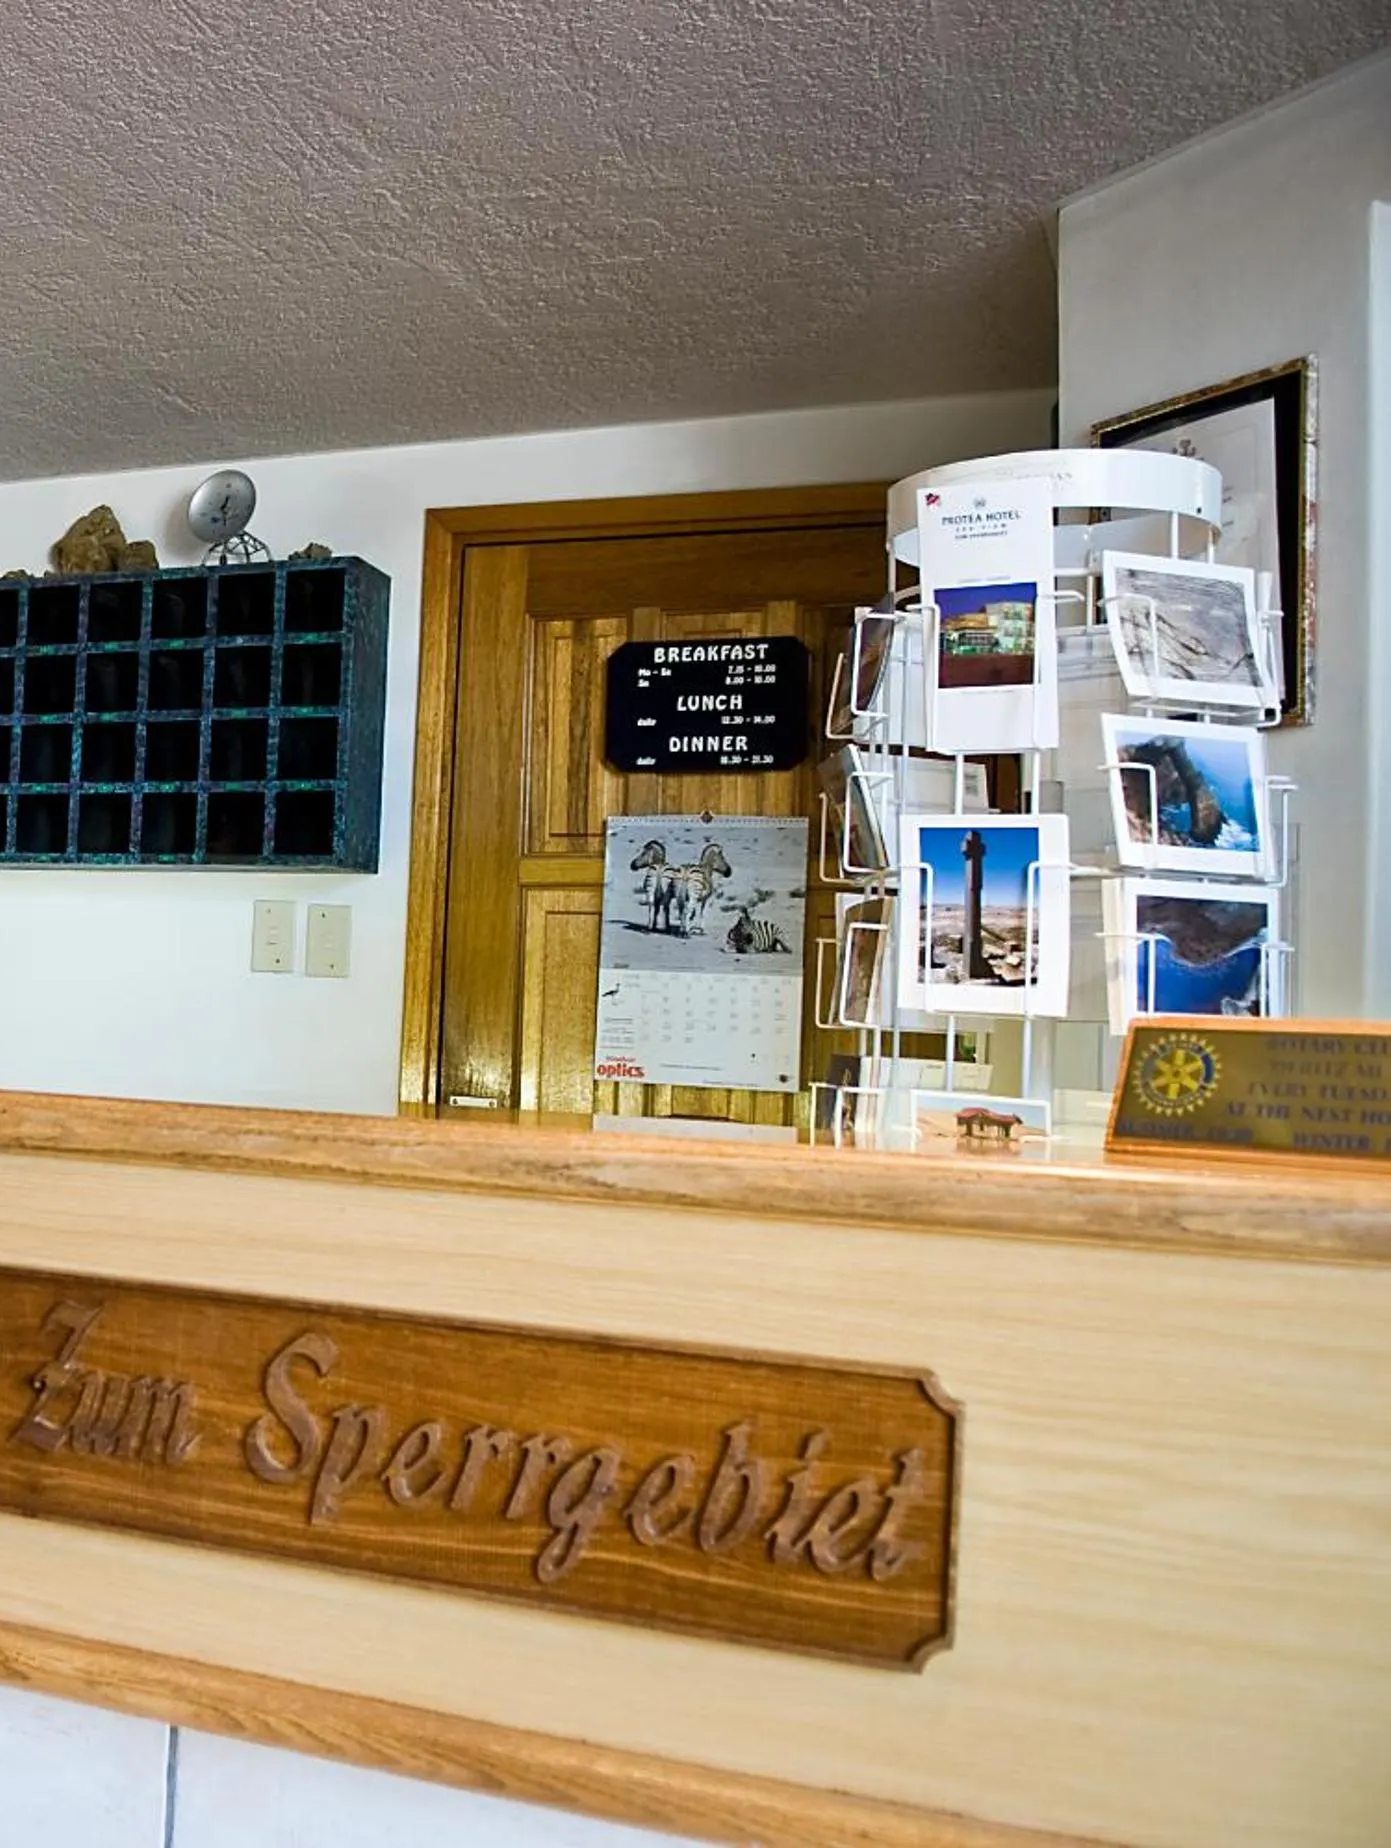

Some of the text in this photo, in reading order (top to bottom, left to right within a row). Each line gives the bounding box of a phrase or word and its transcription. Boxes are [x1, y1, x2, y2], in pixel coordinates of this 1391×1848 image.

[985, 510, 1022, 522] HOTEL
[654, 644, 769, 664] BREAKFAST
[677, 694, 743, 712] LUNCH
[669, 735, 748, 753] DINNER
[597, 1063, 644, 1078] optics
[8, 1299, 203, 1466] Zum
[245, 1331, 925, 1583] Sperrgebiet
